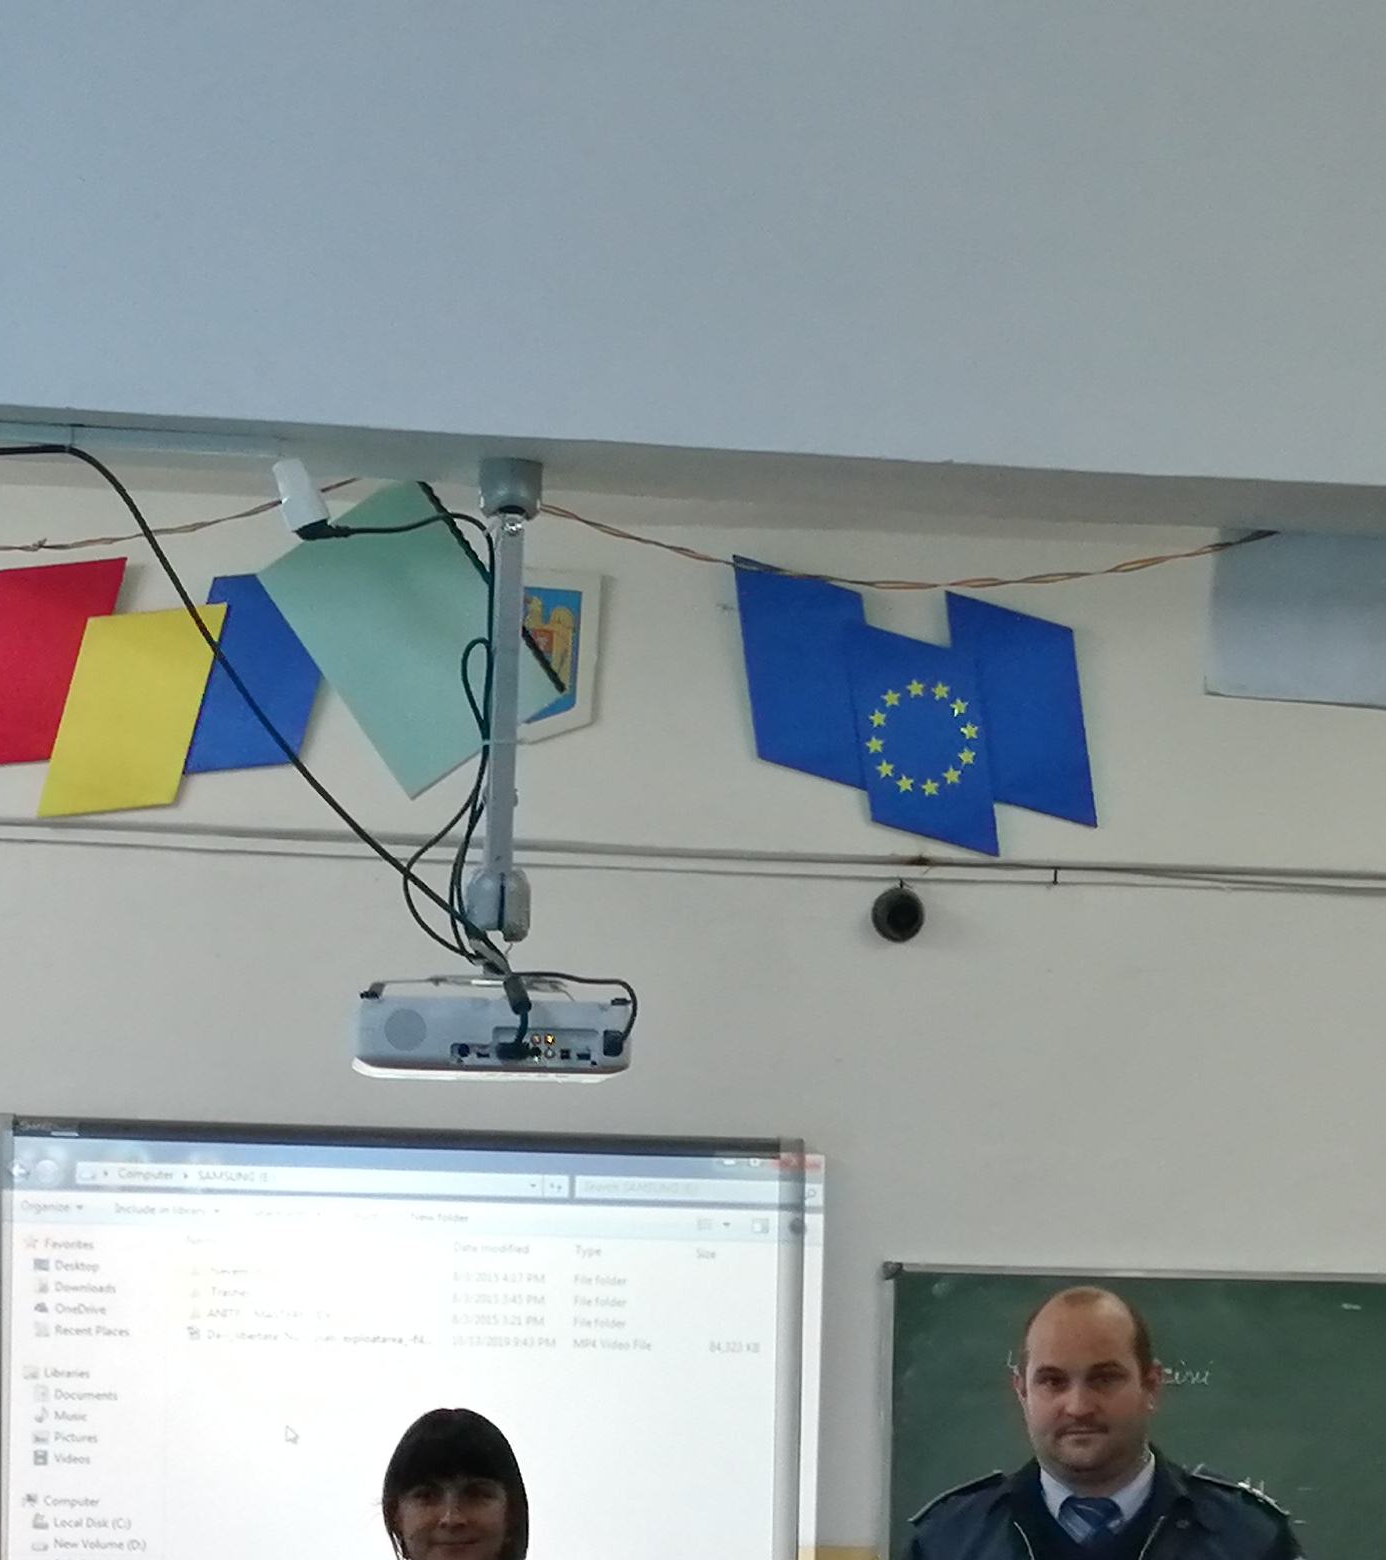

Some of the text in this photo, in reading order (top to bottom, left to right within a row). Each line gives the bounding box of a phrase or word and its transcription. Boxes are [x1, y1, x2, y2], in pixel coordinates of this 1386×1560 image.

[117, 1168, 174, 1182] Computer
[197, 1170, 255, 1182] SAMSUNG
[21, 1200, 70, 1213] Organize
[115, 1202, 156, 1215] Include
[44, 1238, 94, 1250] Favorites
[481, 1243, 530, 1254] modified
[575, 1244, 602, 1259] Type
[696, 1248, 717, 1260] Size
[55, 1260, 100, 1274] Desktop
[526, 1273, 546, 1284] PM
[574, 1273, 627, 1287] File folder
[55, 1281, 116, 1295] Downloads
[526, 1294, 546, 1305] PM
[574, 1294, 627, 1308] File folder
[54, 1303, 106, 1315] OneDrive
[525, 1315, 545, 1326] PM
[573, 1315, 626, 1329] File folder
[54, 1325, 131, 1338] Recent Places
[538, 1336, 557, 1348] PM
[573, 1338, 652, 1352] MP4 Video File
[44, 1368, 90, 1379] Libraries
[54, 1390, 118, 1402] Documents
[54, 1410, 88, 1422] Music
[54, 1432, 98, 1444] Pictures
[54, 1453, 91, 1465] Videos
[44, 1496, 100, 1508] Computer
[53, 1517, 132, 1531] Local Disk (C:)
[53, 1538, 147, 1552] New Volume (D:)
